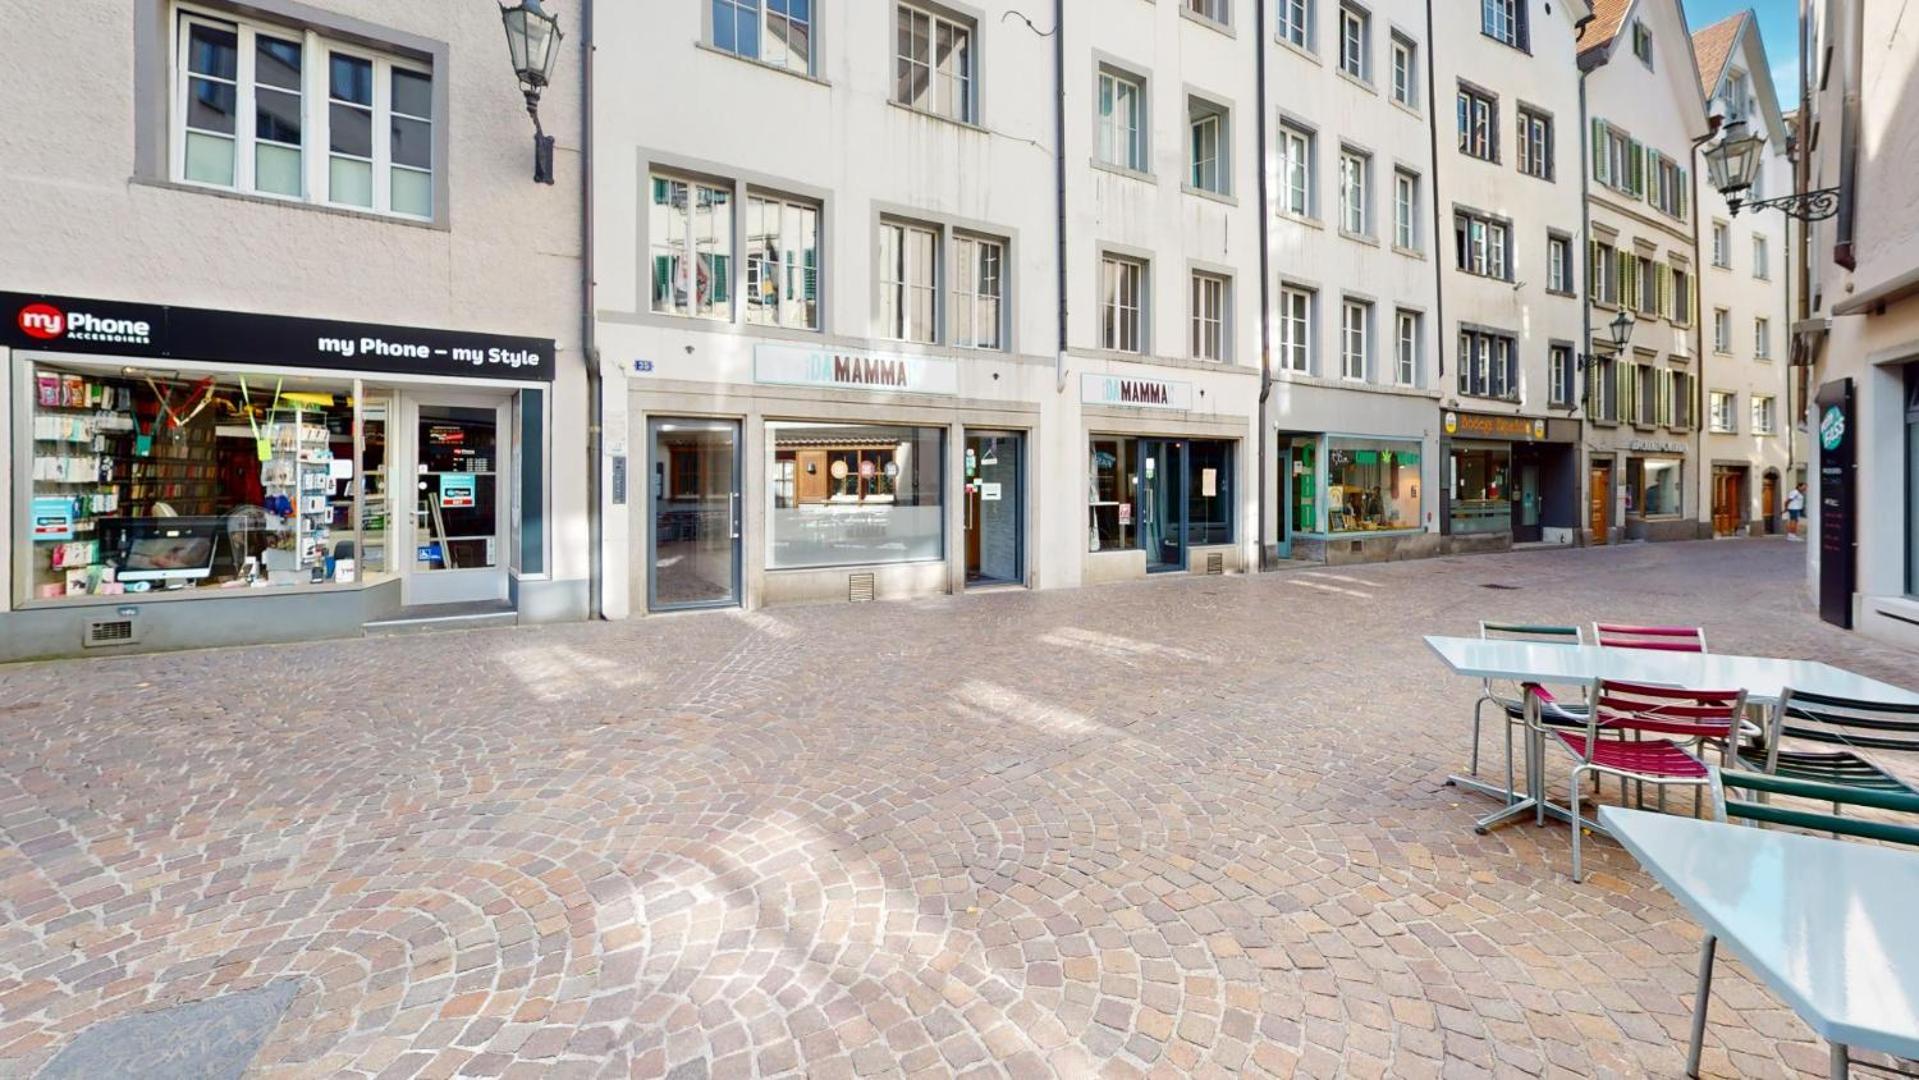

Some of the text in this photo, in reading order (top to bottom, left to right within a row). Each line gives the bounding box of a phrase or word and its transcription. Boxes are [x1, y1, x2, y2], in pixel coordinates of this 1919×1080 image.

[23, 312, 150, 336] my Phone
[67, 331, 150, 344] ACCESSOIRES
[318, 336, 355, 357] my
[360, 337, 430, 359] Phone
[452, 346, 484, 365] my
[488, 347, 540, 368] Style
